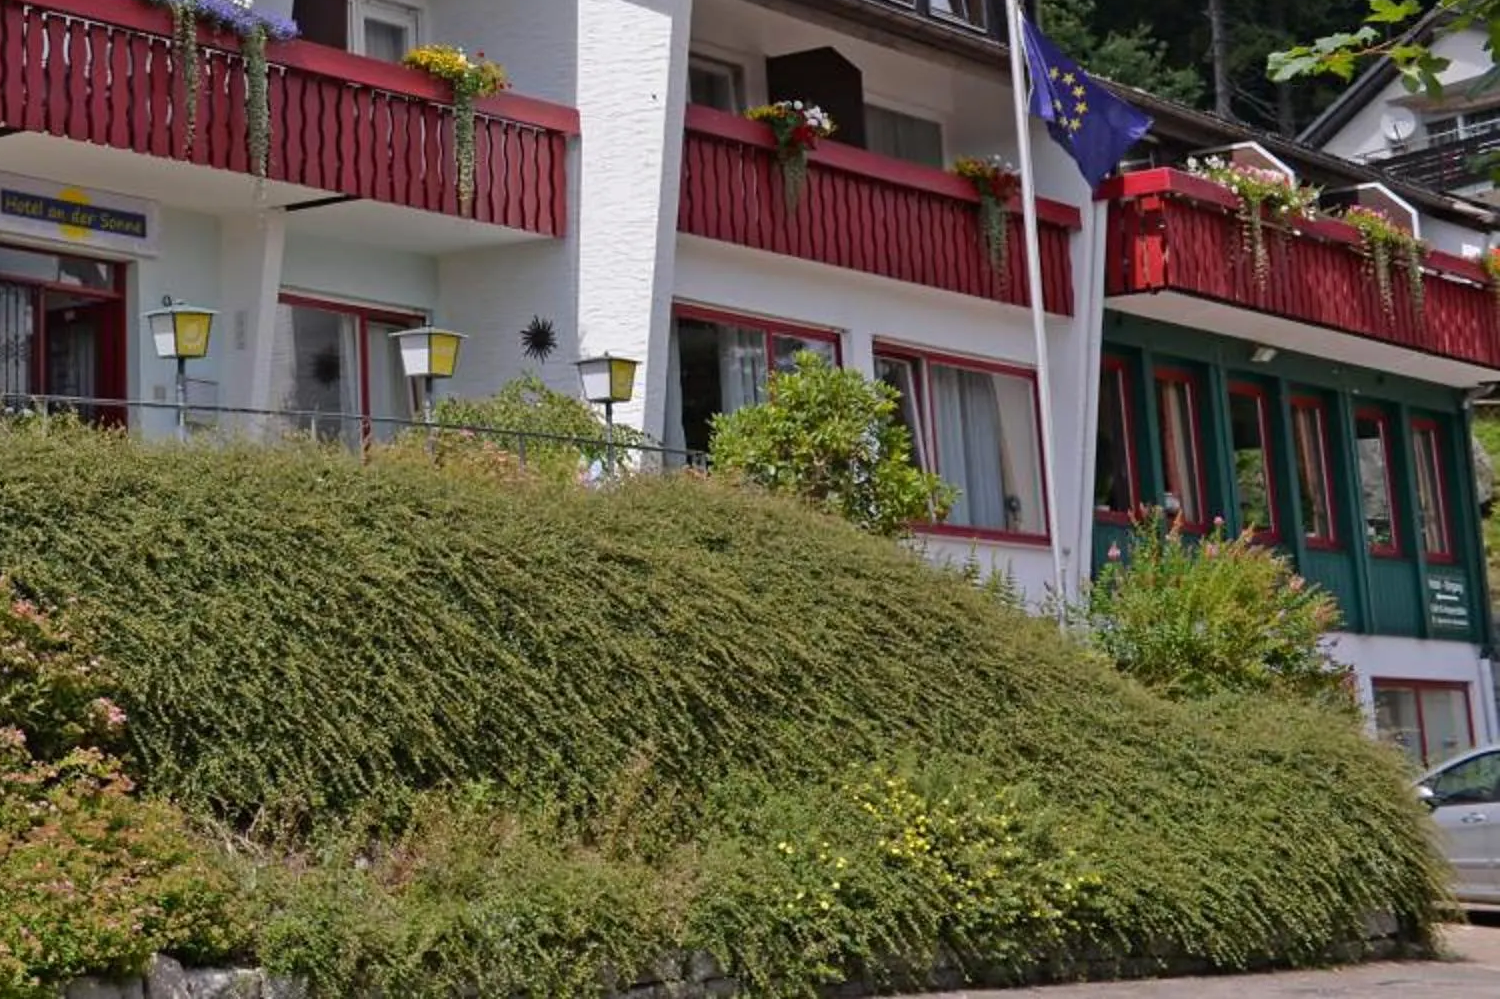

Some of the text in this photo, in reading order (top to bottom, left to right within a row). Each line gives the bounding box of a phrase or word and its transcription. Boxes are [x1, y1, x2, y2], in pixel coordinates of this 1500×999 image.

[4, 195, 143, 235] Hotel an der Sonne
